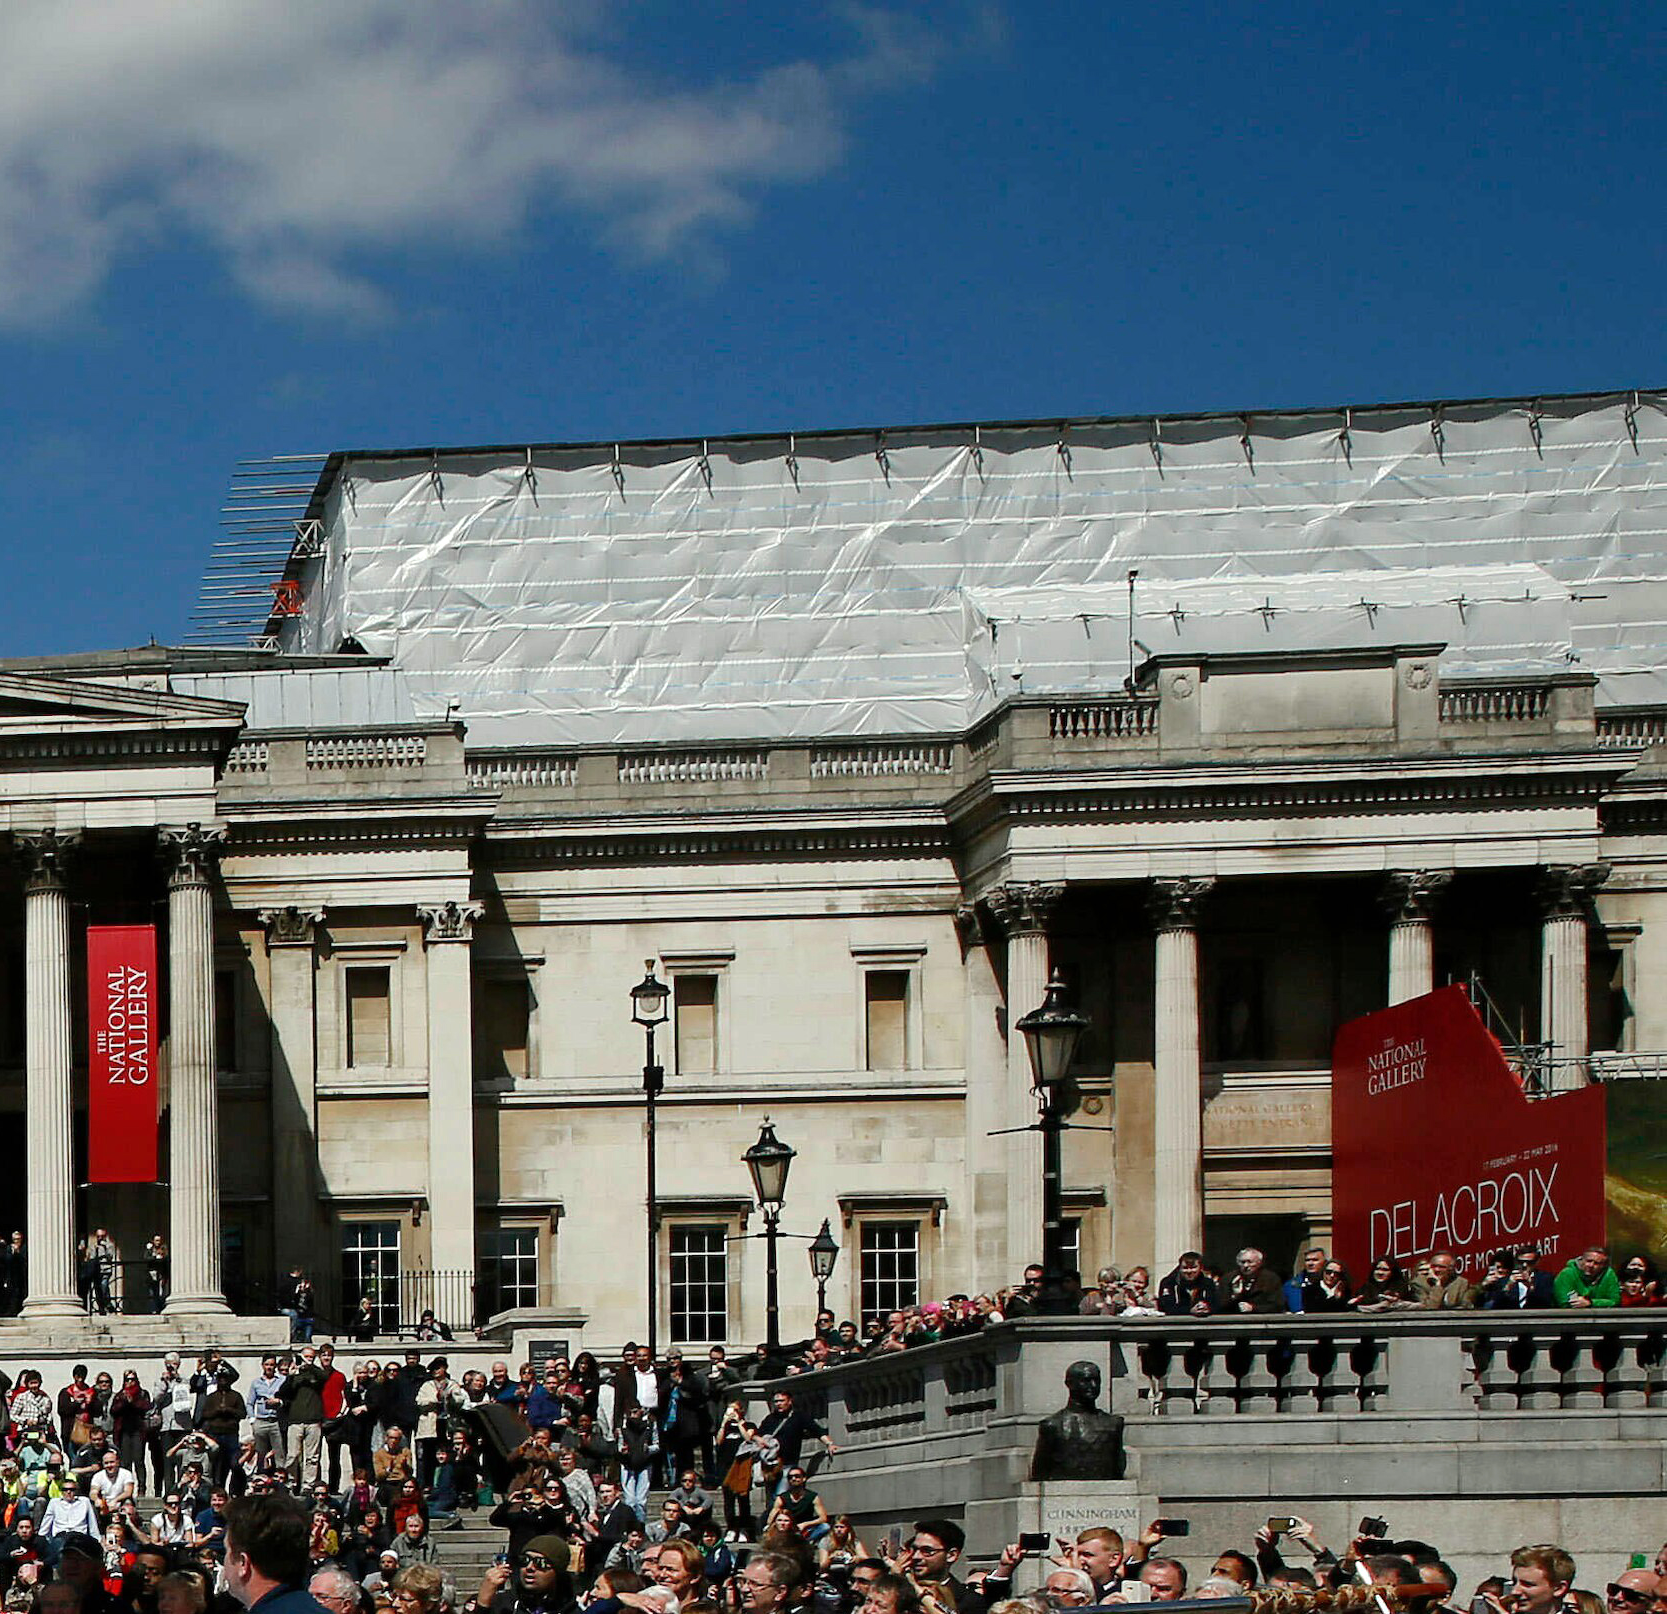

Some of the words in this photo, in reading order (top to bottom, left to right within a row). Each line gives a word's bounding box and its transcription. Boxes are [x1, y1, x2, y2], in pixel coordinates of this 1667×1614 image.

[97, 1029, 107, 1055] THE
[108, 965, 126, 1085] NATIONAL
[127, 966, 149, 1085] GALLERY
[1368, 1037, 1427, 1074] NATIONAL
[1368, 1057, 1427, 1096] GALLERY
[1370, 1162, 1560, 1264] DELACROIX
[1455, 1254, 1471, 1275] OF
[1535, 1235, 1560, 1257] ART
[1047, 1508, 1137, 1520] CUNNINGHAM
